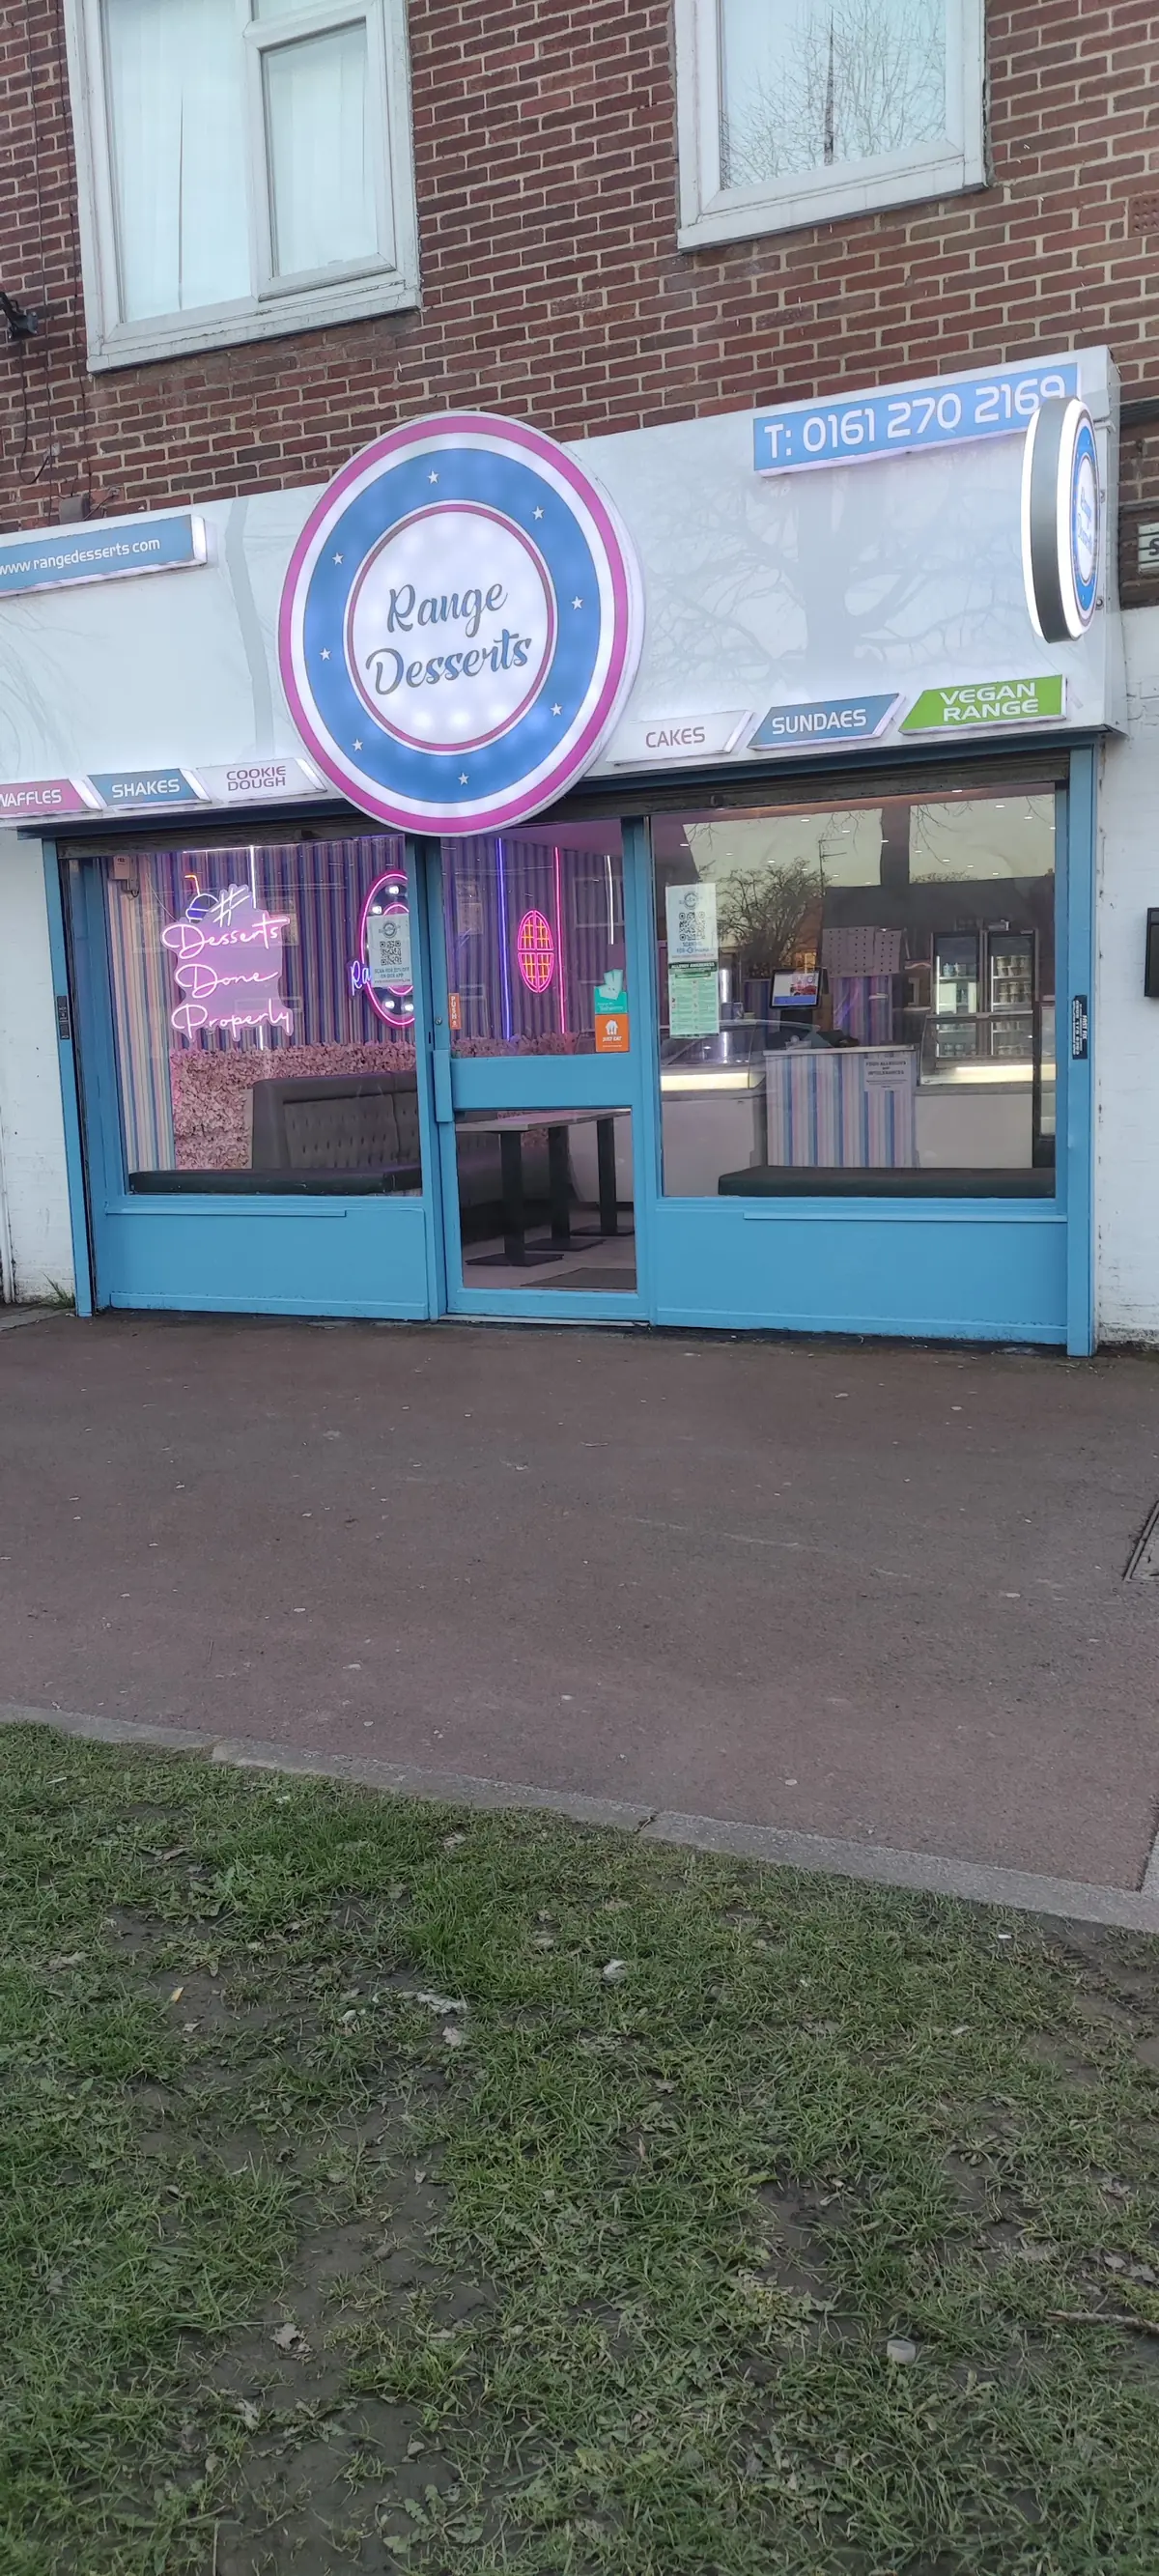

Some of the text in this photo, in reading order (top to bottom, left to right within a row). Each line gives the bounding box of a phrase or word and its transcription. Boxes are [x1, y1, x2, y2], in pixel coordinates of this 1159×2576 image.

[764, 374, 1066, 459] T: 0161 270 2169
[386, 582, 509, 638] Range
[365, 628, 532, 695] Desserts
[939, 682, 1036, 706] VEGAN
[772, 708, 867, 735] SUNDAES
[943, 698, 1039, 722] RANGE
[645, 726, 706, 749] CAKES
[226, 765, 287, 779] COOKIE
[227, 778, 287, 791] DOUGH
[111, 778, 181, 799] SHAKES
[161, 913, 289, 959] Desserts
[175, 963, 279, 999] Done
[171, 999, 291, 1039] Properly
